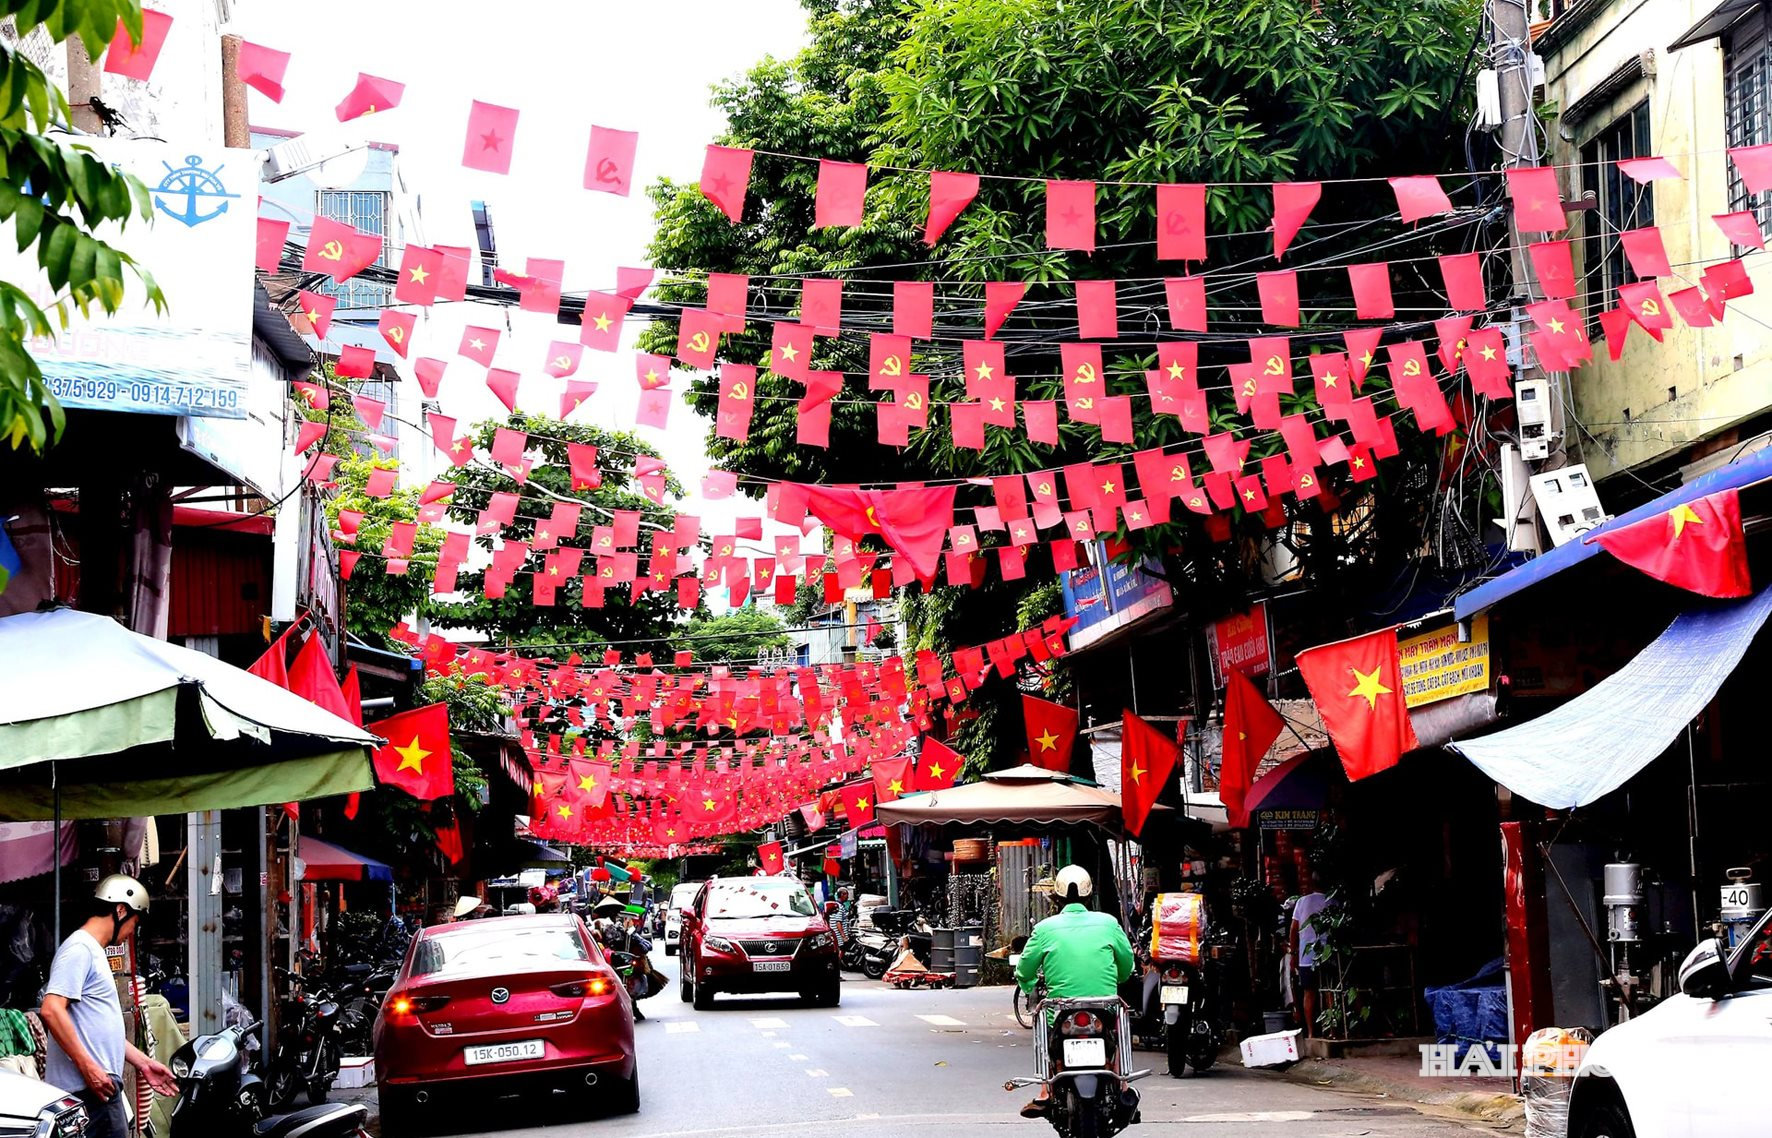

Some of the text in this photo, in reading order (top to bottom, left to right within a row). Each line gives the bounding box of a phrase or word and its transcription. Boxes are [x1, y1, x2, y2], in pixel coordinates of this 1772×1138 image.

[53, 377, 82, 397] 375
[87, 379, 116, 400] 929
[131, 382, 171, 404] 0914
[175, 386, 204, 406] 712
[210, 389, 237, 408] 159
[473, 1043, 537, 1061] 15K-050.12
